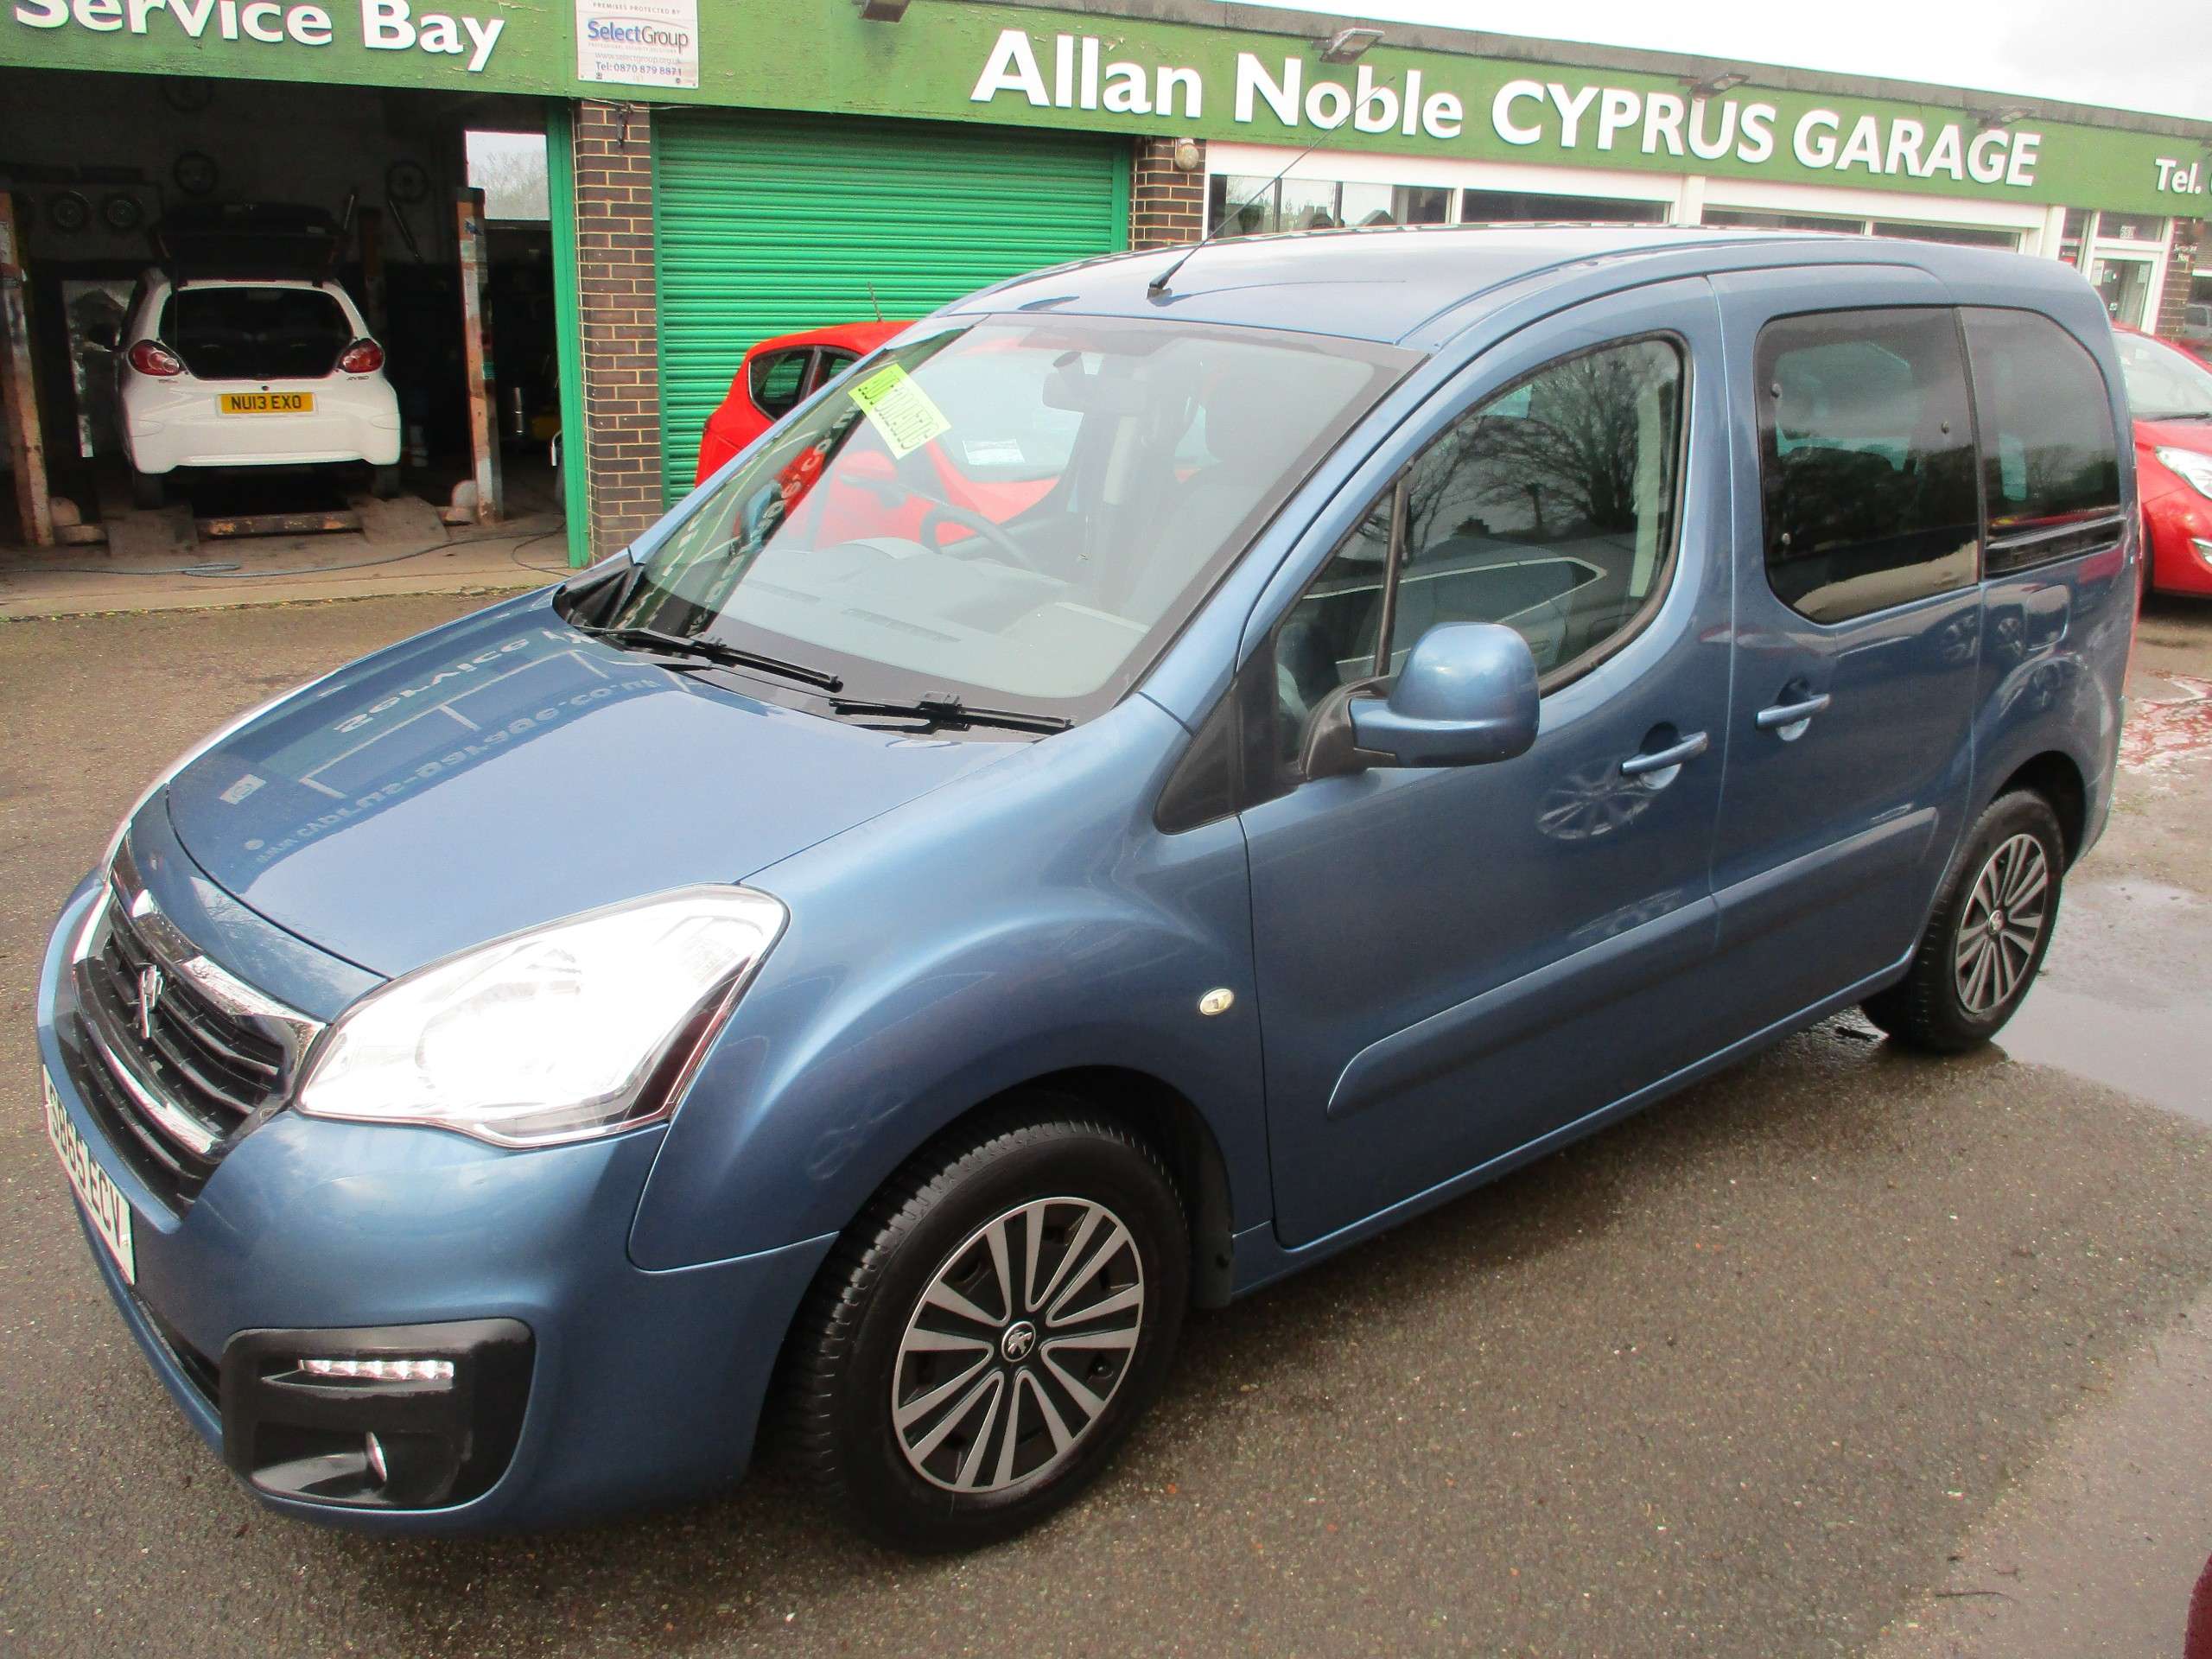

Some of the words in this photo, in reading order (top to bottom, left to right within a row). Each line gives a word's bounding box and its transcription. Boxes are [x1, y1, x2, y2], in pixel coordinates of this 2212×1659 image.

[630, 5, 670, 15] PROTECTED
[360, 0, 505, 72] Bay
[588, 20, 689, 54] SelectGroup
[596, 61, 613, 71] Tel:
[614, 63, 638, 73] 0870
[639, 66, 657, 74] 879
[659, 67, 682, 76] 8871
[969, 29, 1202, 118] Allan
[1234, 53, 1464, 138] Noble
[1491, 80, 1776, 163] CYPRUS
[1793, 110, 2041, 187] GARAGE
[2155, 158, 2202, 194] Tel.
[231, 395, 266, 410] NU13
[271, 395, 302, 410] EXO
